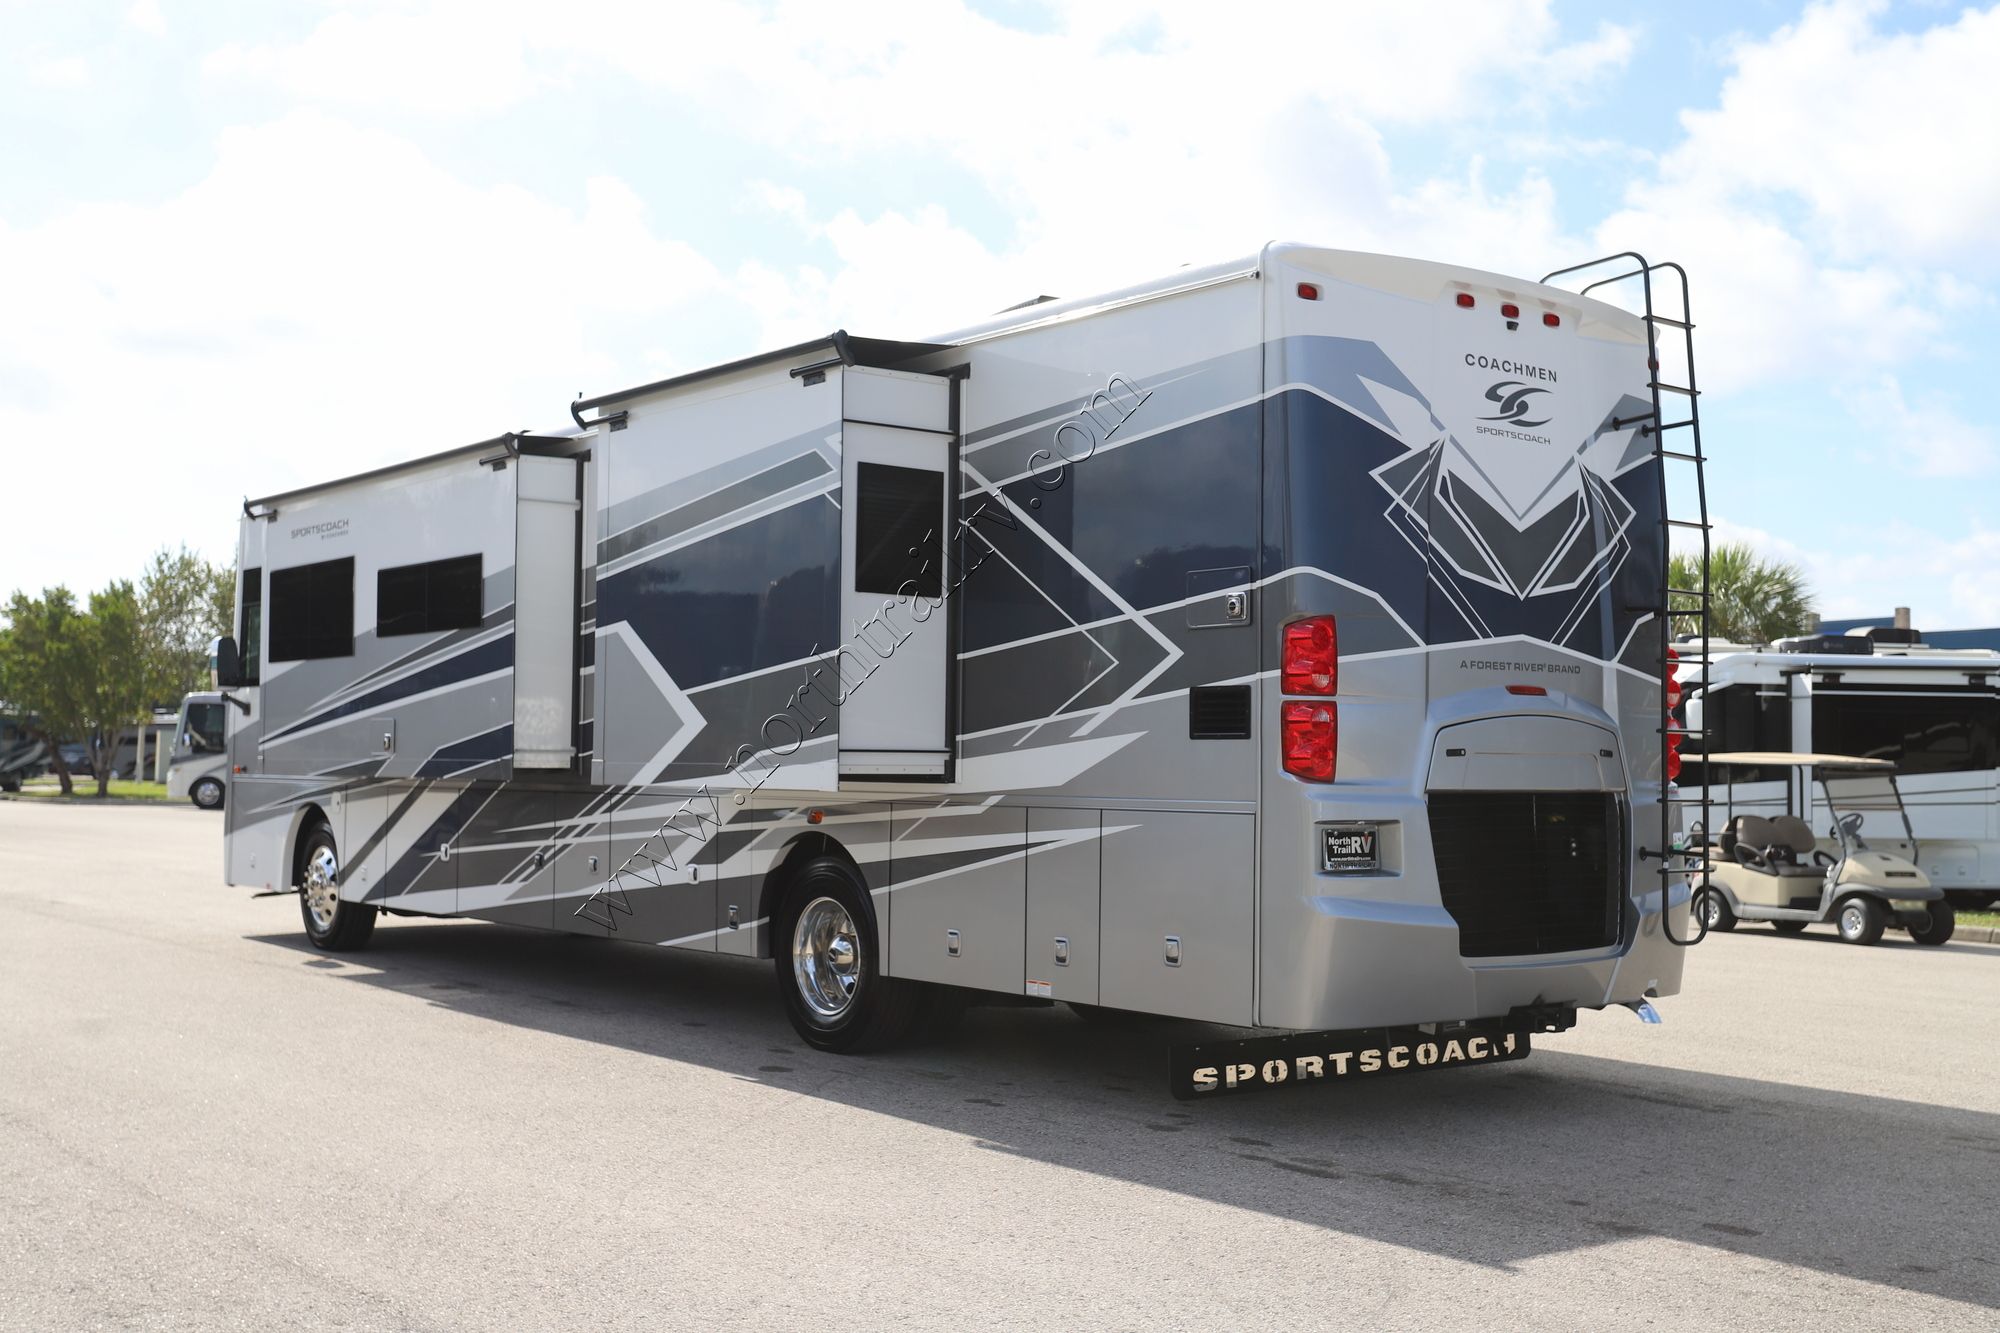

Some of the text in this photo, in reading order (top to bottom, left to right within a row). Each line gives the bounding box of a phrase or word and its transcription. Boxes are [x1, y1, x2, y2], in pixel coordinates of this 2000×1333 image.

[1465, 353, 1557, 383] COACHMEN
[1476, 425, 1551, 445] SPORTSCOACH
[290, 518, 350, 540] SPORTSCOACH
[1460, 660, 1468, 670] A
[1470, 660, 1512, 671] FOREST
[1547, 664, 1581, 675] BRAND
[1328, 836, 1351, 846] North
[1332, 845, 1351, 854] Trail
[1351, 836, 1372, 854] RV
